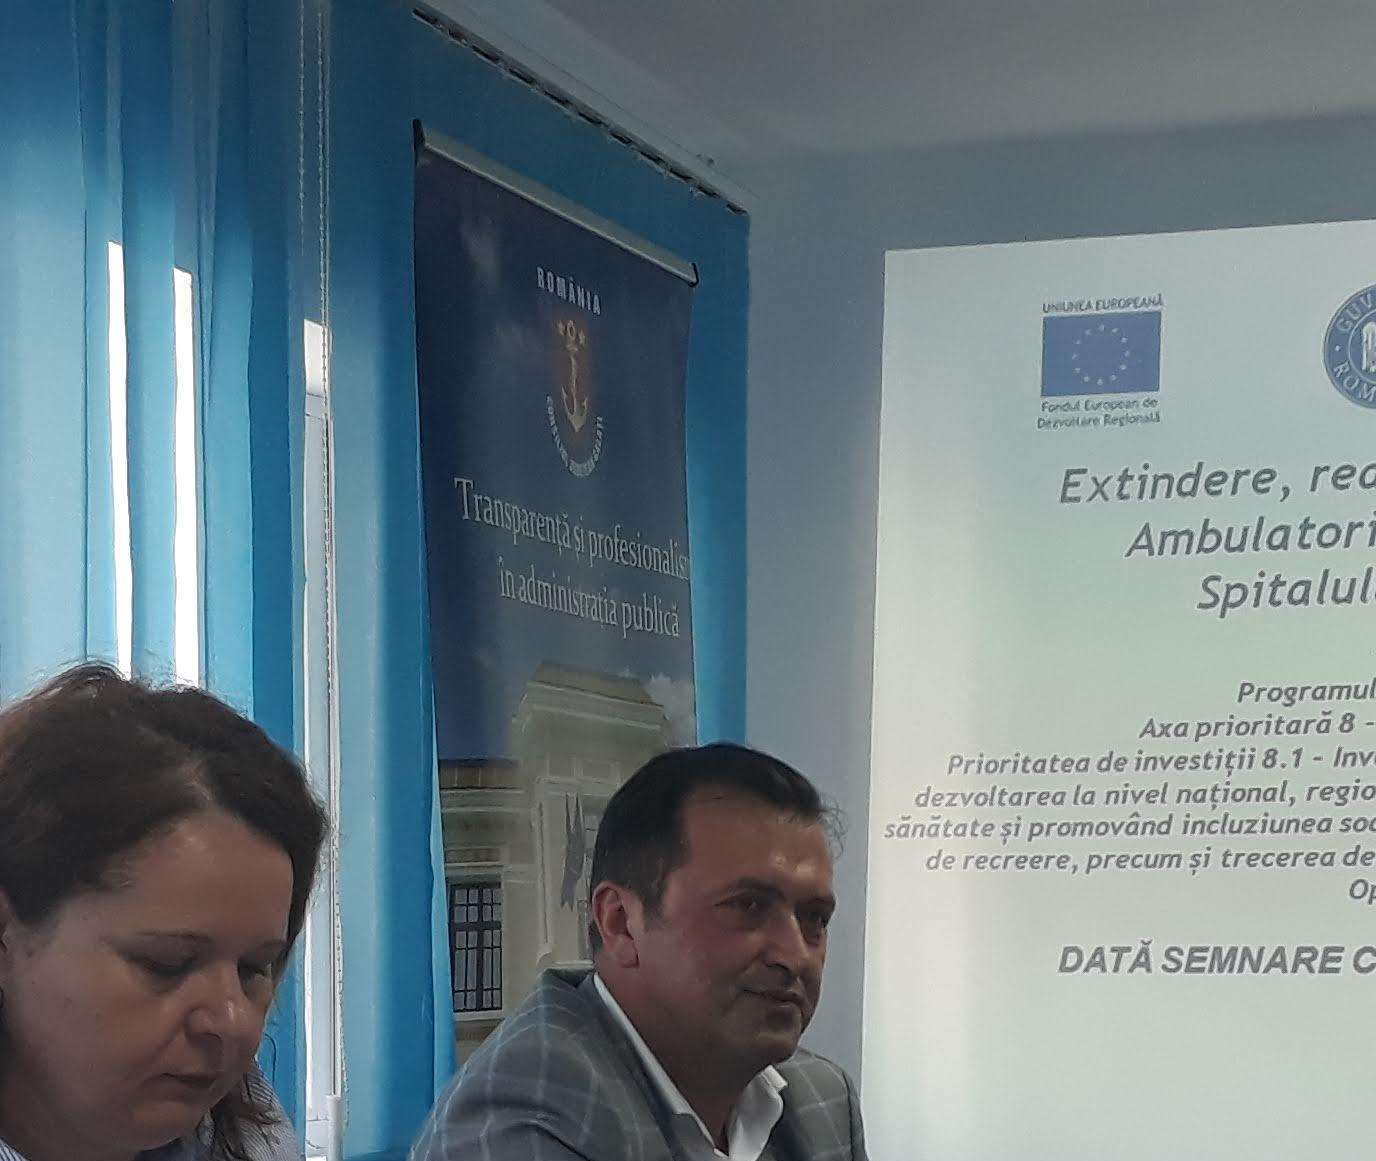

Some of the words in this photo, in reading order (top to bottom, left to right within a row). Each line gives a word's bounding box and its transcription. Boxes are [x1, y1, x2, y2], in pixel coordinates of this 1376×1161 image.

[537, 267, 601, 315] ROMÂNIA
[1060, 461, 1291, 504] Extindere,
[454, 477, 571, 555] Transparență
[574, 514, 585, 560] și
[498, 556, 515, 599] în
[519, 564, 617, 629] administrația
[622, 591, 680, 639] publică
[1139, 717, 1189, 739] Axa
[1194, 710, 1333, 743] prioritară
[1338, 712, 1356, 734] 8
[947, 752, 1090, 776] Prioritatea
[1096, 751, 1127, 773] de
[1134, 748, 1256, 776] investiții
[1262, 747, 1303, 770] 8.1
[914, 785, 1065, 808] dezvoltarea
[1072, 784, 1095, 806] la
[1104, 782, 1169, 805] nivel
[1176, 780, 1296, 811] național,
[884, 814, 994, 839] sănătate
[1000, 814, 1022, 845] și
[1027, 811, 1173, 841] promovând
[1181, 811, 1333, 836] incluziunea
[926, 849, 956, 870] de
[962, 851, 1078, 874] recreere,
[1085, 850, 1182, 875] precum
[1188, 847, 1211, 876] și
[1221, 847, 1335, 869] trecerea
[1342, 845, 1376, 867] de
[1058, 939, 1154, 975] DATĂ
[1161, 945, 1346, 975] SEMNARE
